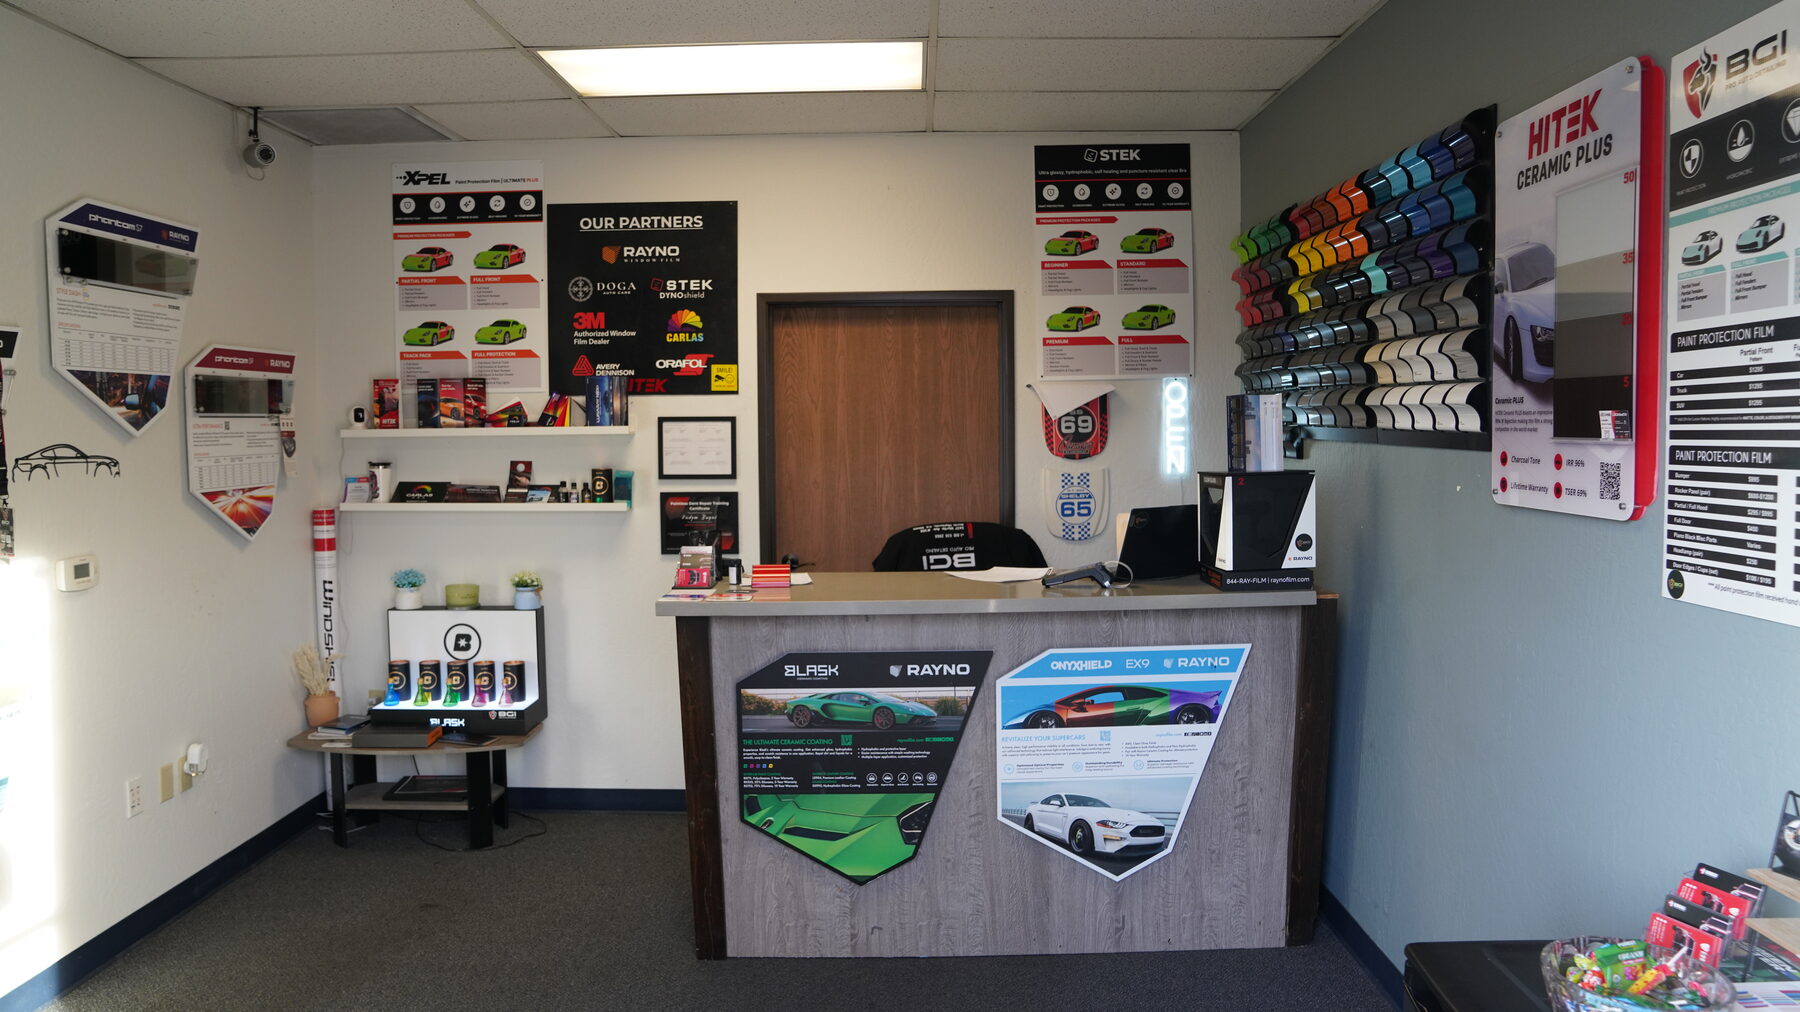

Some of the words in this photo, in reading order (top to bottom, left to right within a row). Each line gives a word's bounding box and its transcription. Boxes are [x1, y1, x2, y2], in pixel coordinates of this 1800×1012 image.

[1726, 30, 1787, 80] BGI
[1528, 88, 1603, 160] HITEK
[1100, 149, 1140, 161] STEK
[1517, 151, 1571, 190] CERAMIC
[1576, 134, 1613, 167] PLUS
[403, 171, 450, 185] XPEL
[1623, 170, 1635, 184] 50
[88, 214, 135, 230] phantom
[580, 217, 614, 229] OUR
[620, 216, 703, 229] PARTNERS
[168, 230, 189, 241] RAYNO
[623, 246, 680, 257] RAYNO
[1623, 252, 1633, 264] 35
[597, 282, 636, 291] DOGA
[667, 280, 712, 291] STEK
[573, 312, 605, 329] 3M
[666, 333, 704, 342] CARLAS
[1677, 335, 1696, 347] PAINT
[1699, 328, 1751, 345] PROTECTION
[1754, 325, 1774, 339] FILM
[215, 356, 248, 364] phantom
[270, 360, 290, 368] RAYNO
[655, 360, 707, 368] ORAFOL
[627, 378, 668, 392] ITEK
[1624, 376, 1629, 388] 5
[1495, 397, 1512, 405] Ceramic
[1513, 396, 1524, 404] PLUS
[1061, 416, 1093, 433] 69
[1165, 382, 1187, 474] OPEN
[1511, 456, 1530, 464] Charcoal
[1676, 450, 1695, 460] PAINT
[1697, 451, 1749, 463] PROTECTION
[1751, 452, 1772, 464] FILM
[1511, 482, 1527, 490] Lifetime
[1528, 484, 1548, 494] Warranty
[1565, 488, 1576, 496] TSER
[1576, 489, 1587, 497] 69%
[1061, 501, 1092, 517] 65
[922, 552, 976, 570] BGI
[1683, 563, 1694, 571] Edges
[1733, 588, 1754, 598] protection
[1051, 660, 1112, 671] ONYXHIELD
[1125, 659, 1150, 669] EX9
[1178, 657, 1230, 667] RAYNO
[784, 665, 838, 677] BLASK
[907, 664, 970, 676] RAYNO
